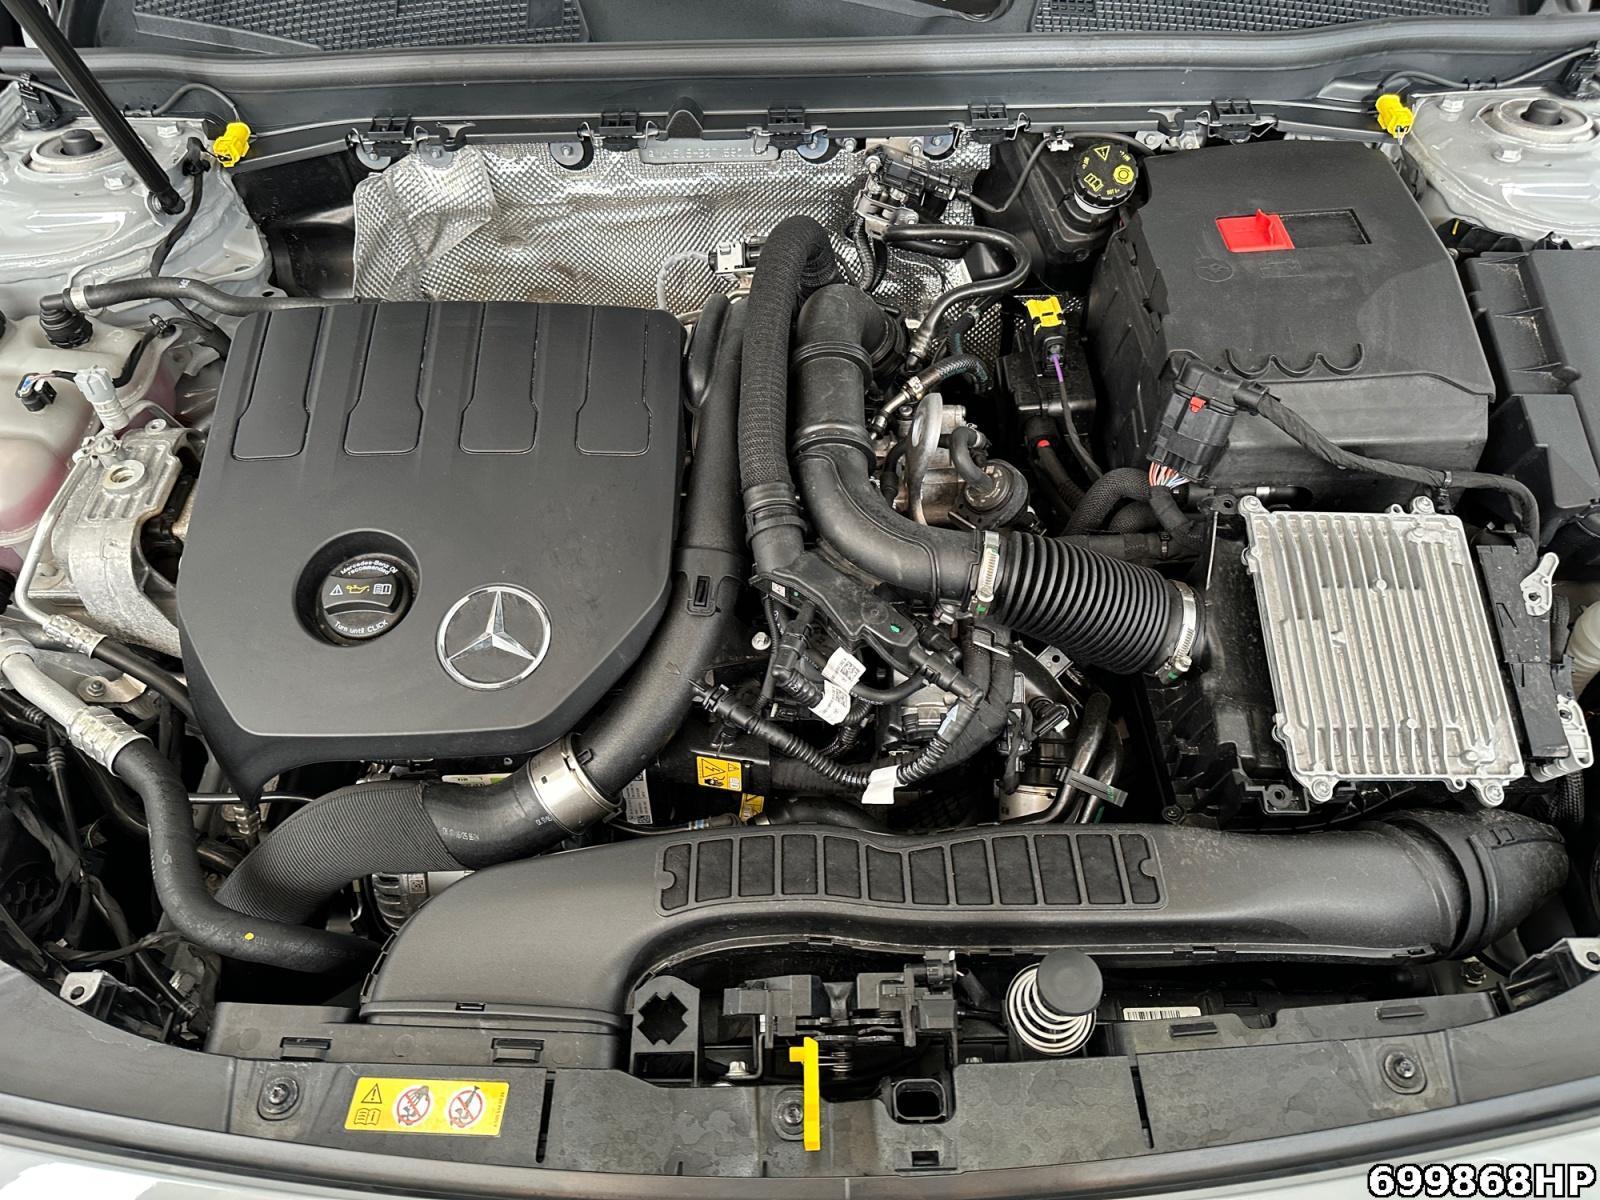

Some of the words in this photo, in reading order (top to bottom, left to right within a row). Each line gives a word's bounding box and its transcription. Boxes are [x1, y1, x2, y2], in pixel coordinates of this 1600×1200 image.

[340, 560, 390, 574] Mercedes-Benz
[348, 566, 390, 575] recommended
[335, 620, 348, 632] Turn
[349, 626, 365, 634] until
[367, 619, 389, 633] CLICK
